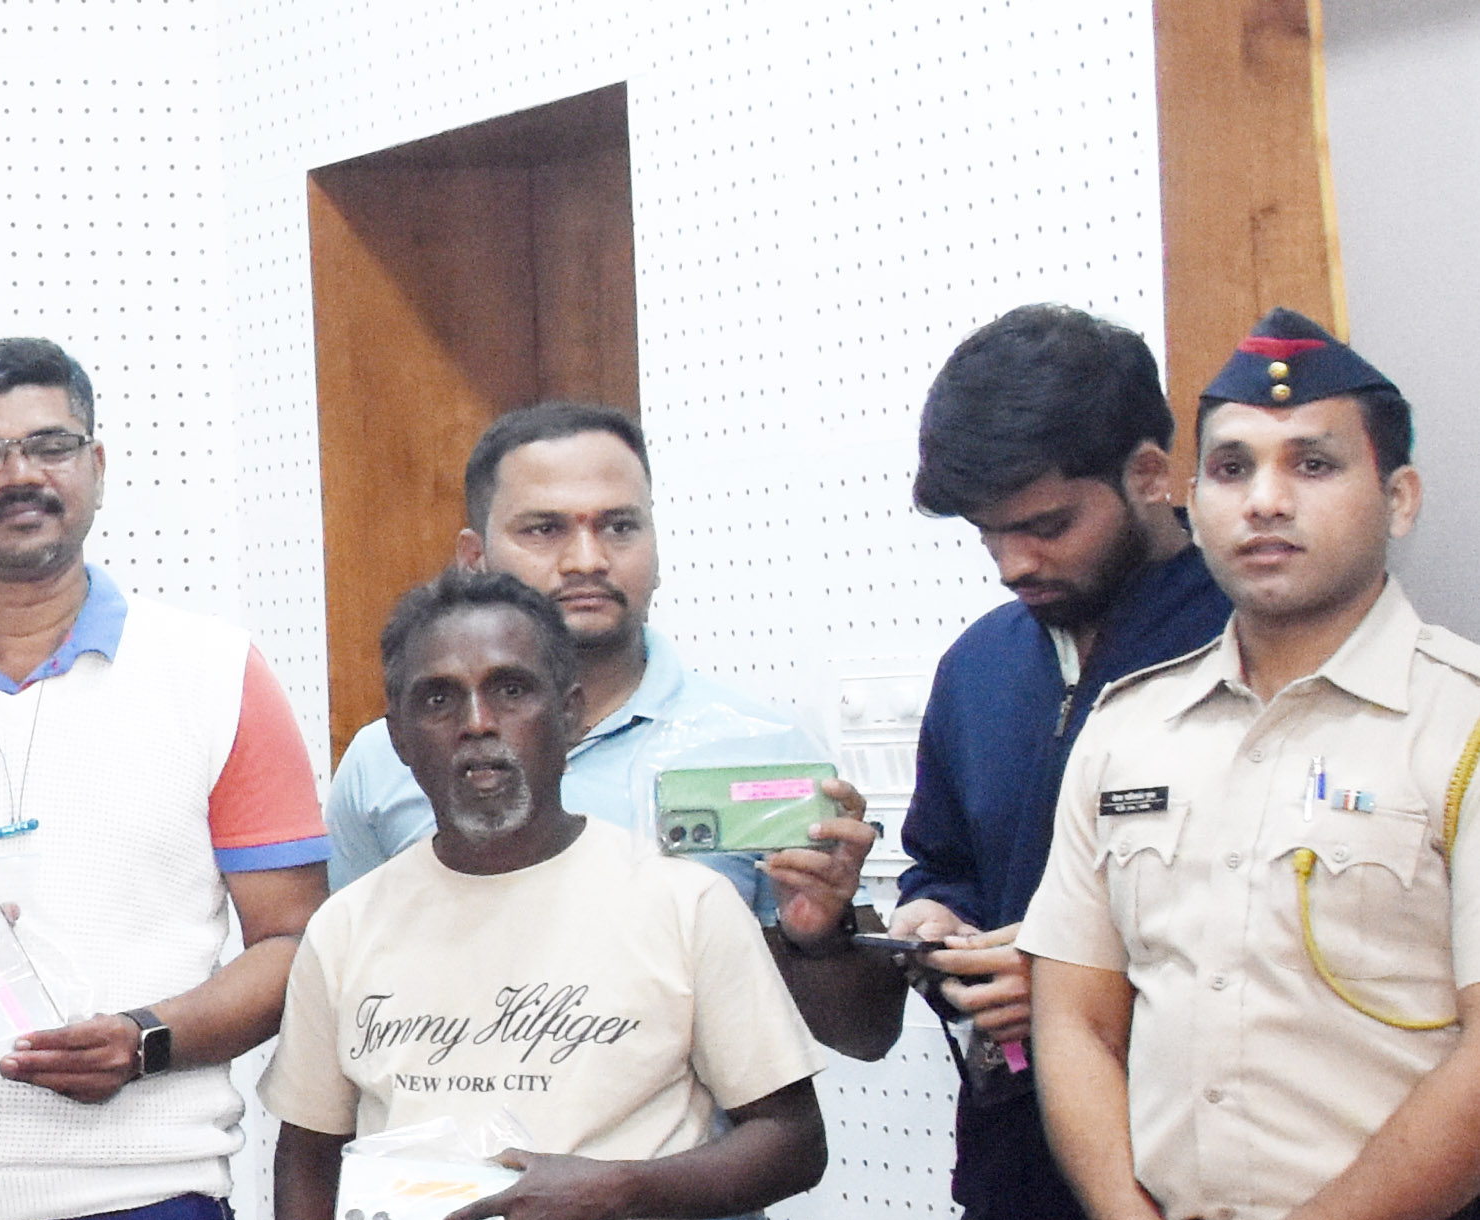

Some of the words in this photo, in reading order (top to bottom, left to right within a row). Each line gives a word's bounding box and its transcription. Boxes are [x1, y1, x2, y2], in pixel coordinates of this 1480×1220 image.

[350, 992, 470, 1066] Tommy
[473, 982, 642, 1065] Hilfiger
[394, 1073, 442, 1092] NEW
[446, 1075, 497, 1093] YORK
[503, 1074, 552, 1092] CITY
